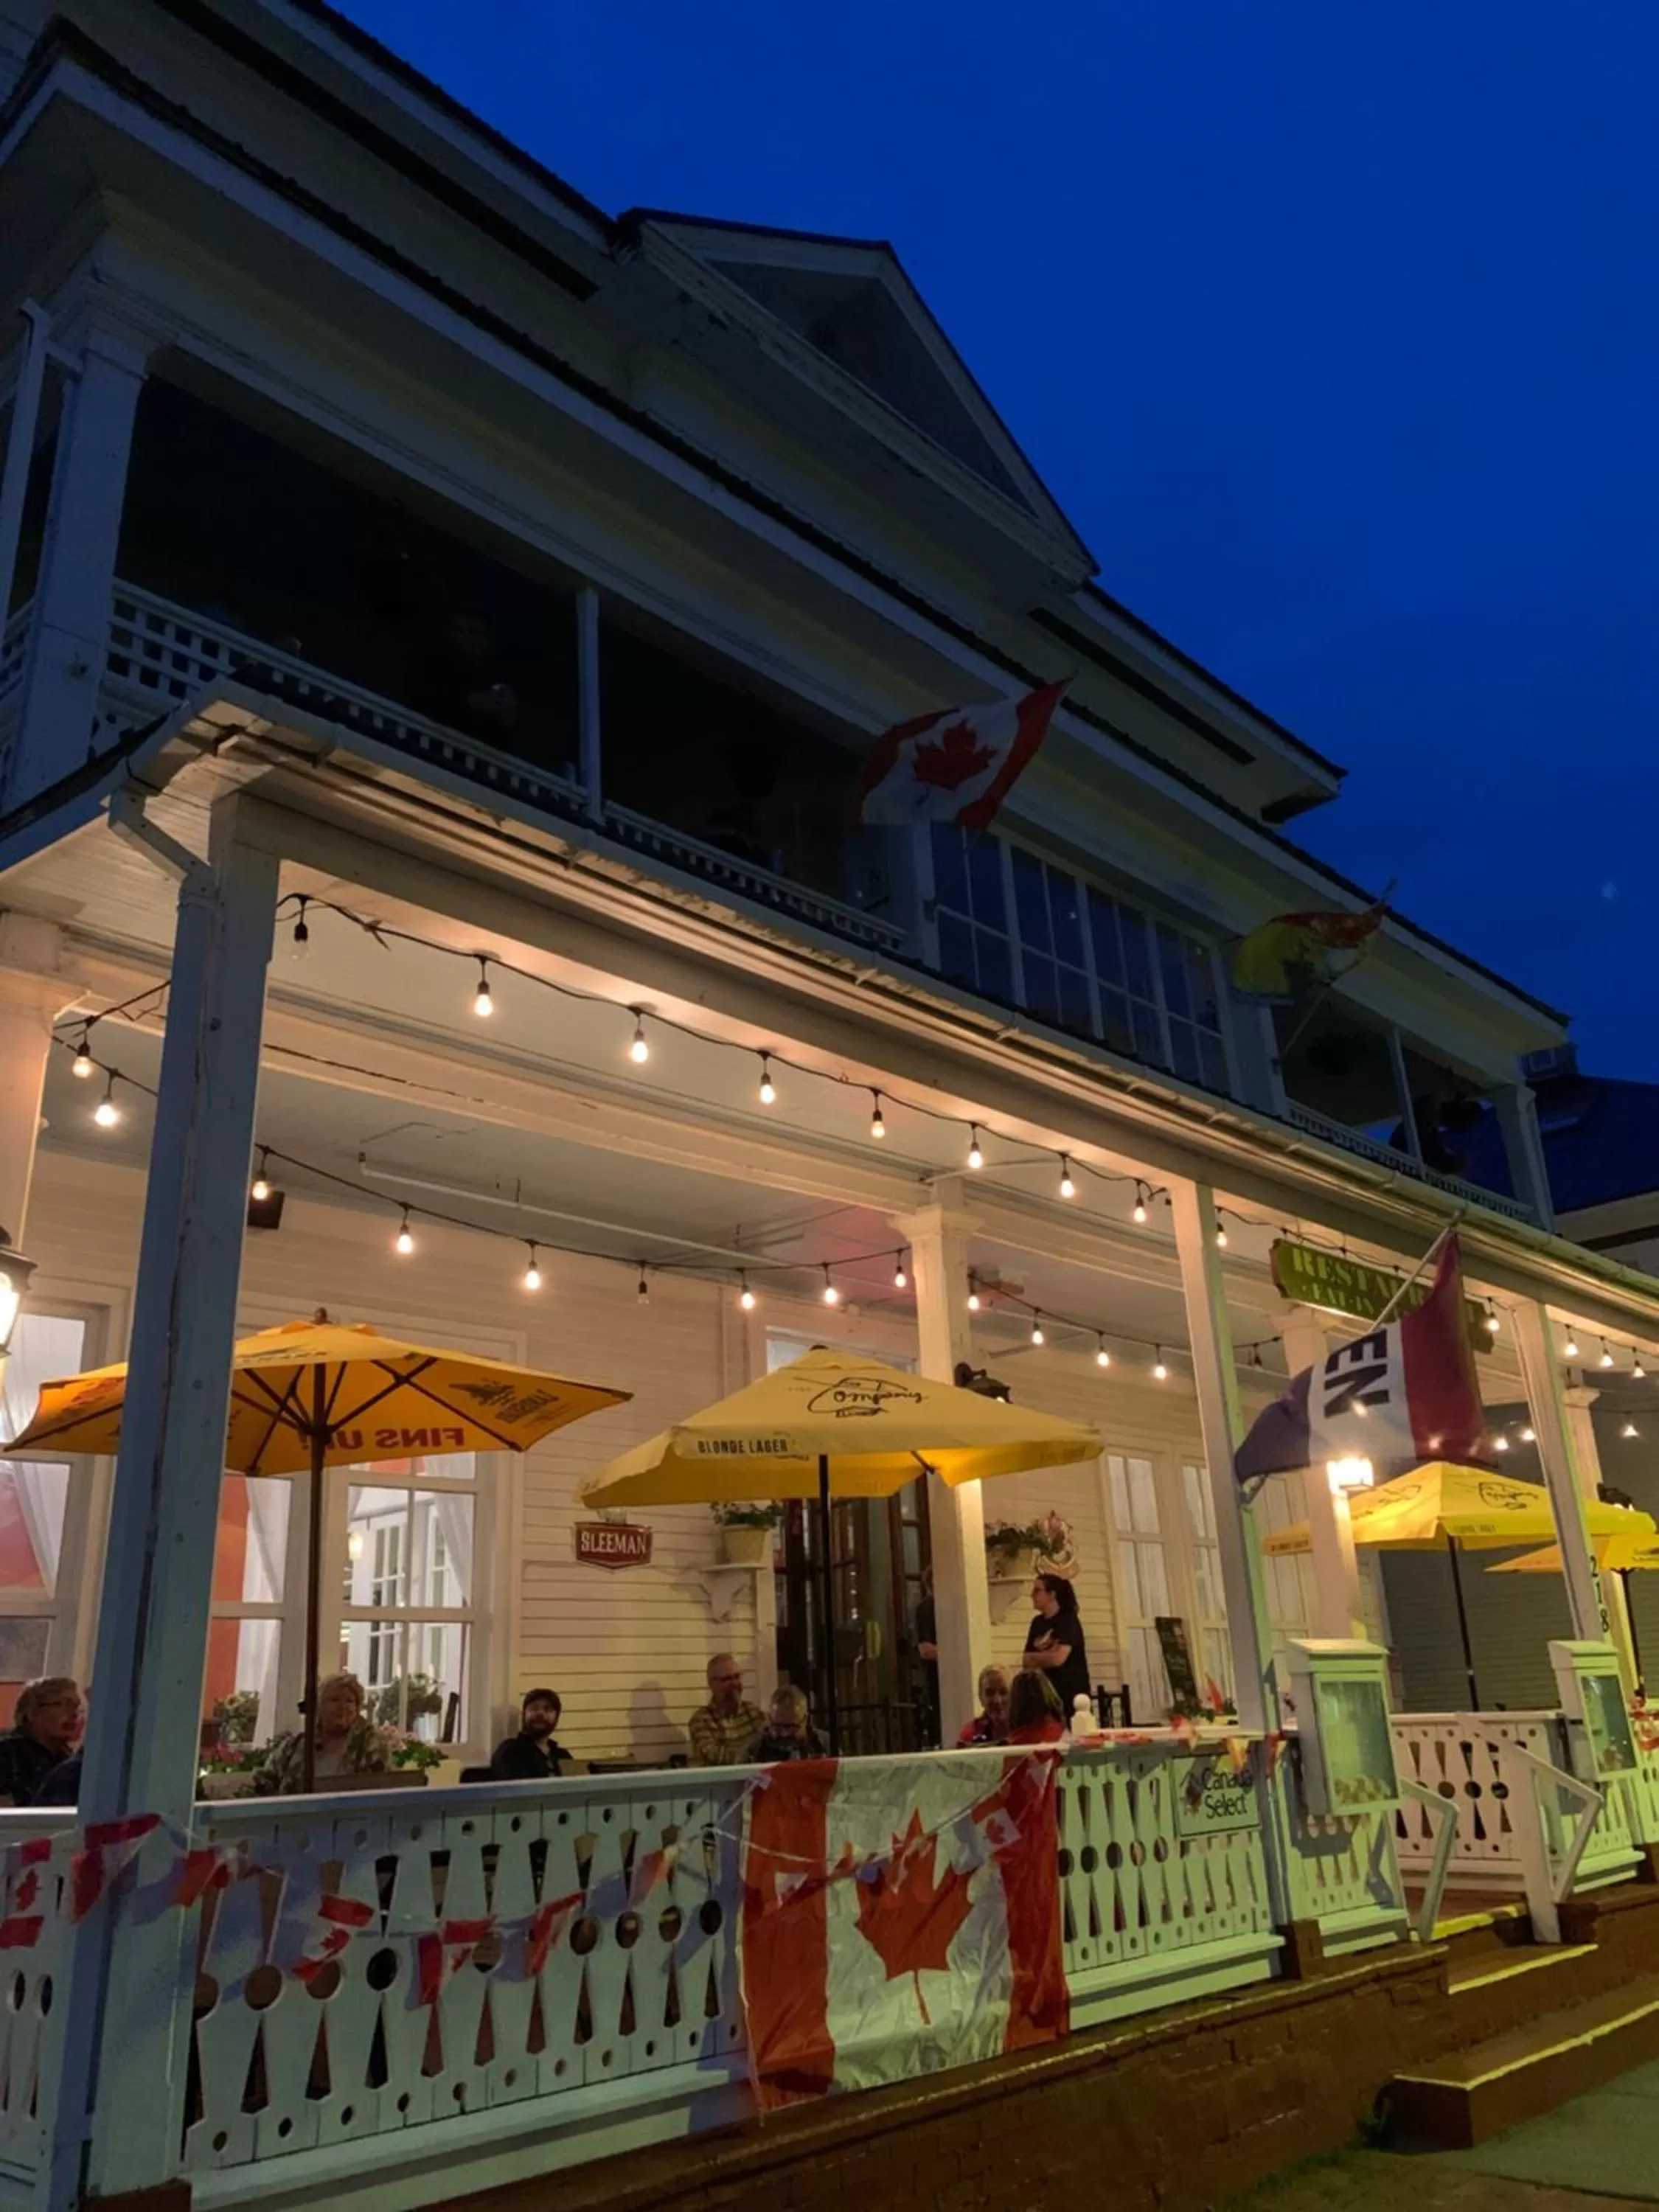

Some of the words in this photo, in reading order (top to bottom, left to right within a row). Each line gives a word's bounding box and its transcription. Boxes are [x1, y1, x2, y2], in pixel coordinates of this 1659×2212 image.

[1324, 1327, 1390, 1419] EN
[697, 1439, 745, 1454] BLONDE
[748, 1439, 788, 1453] LAGER
[580, 1531, 647, 1555] SLEEMAN
[1590, 1555, 1610, 1633] 218
[1205, 1793, 1248, 1819] Select
